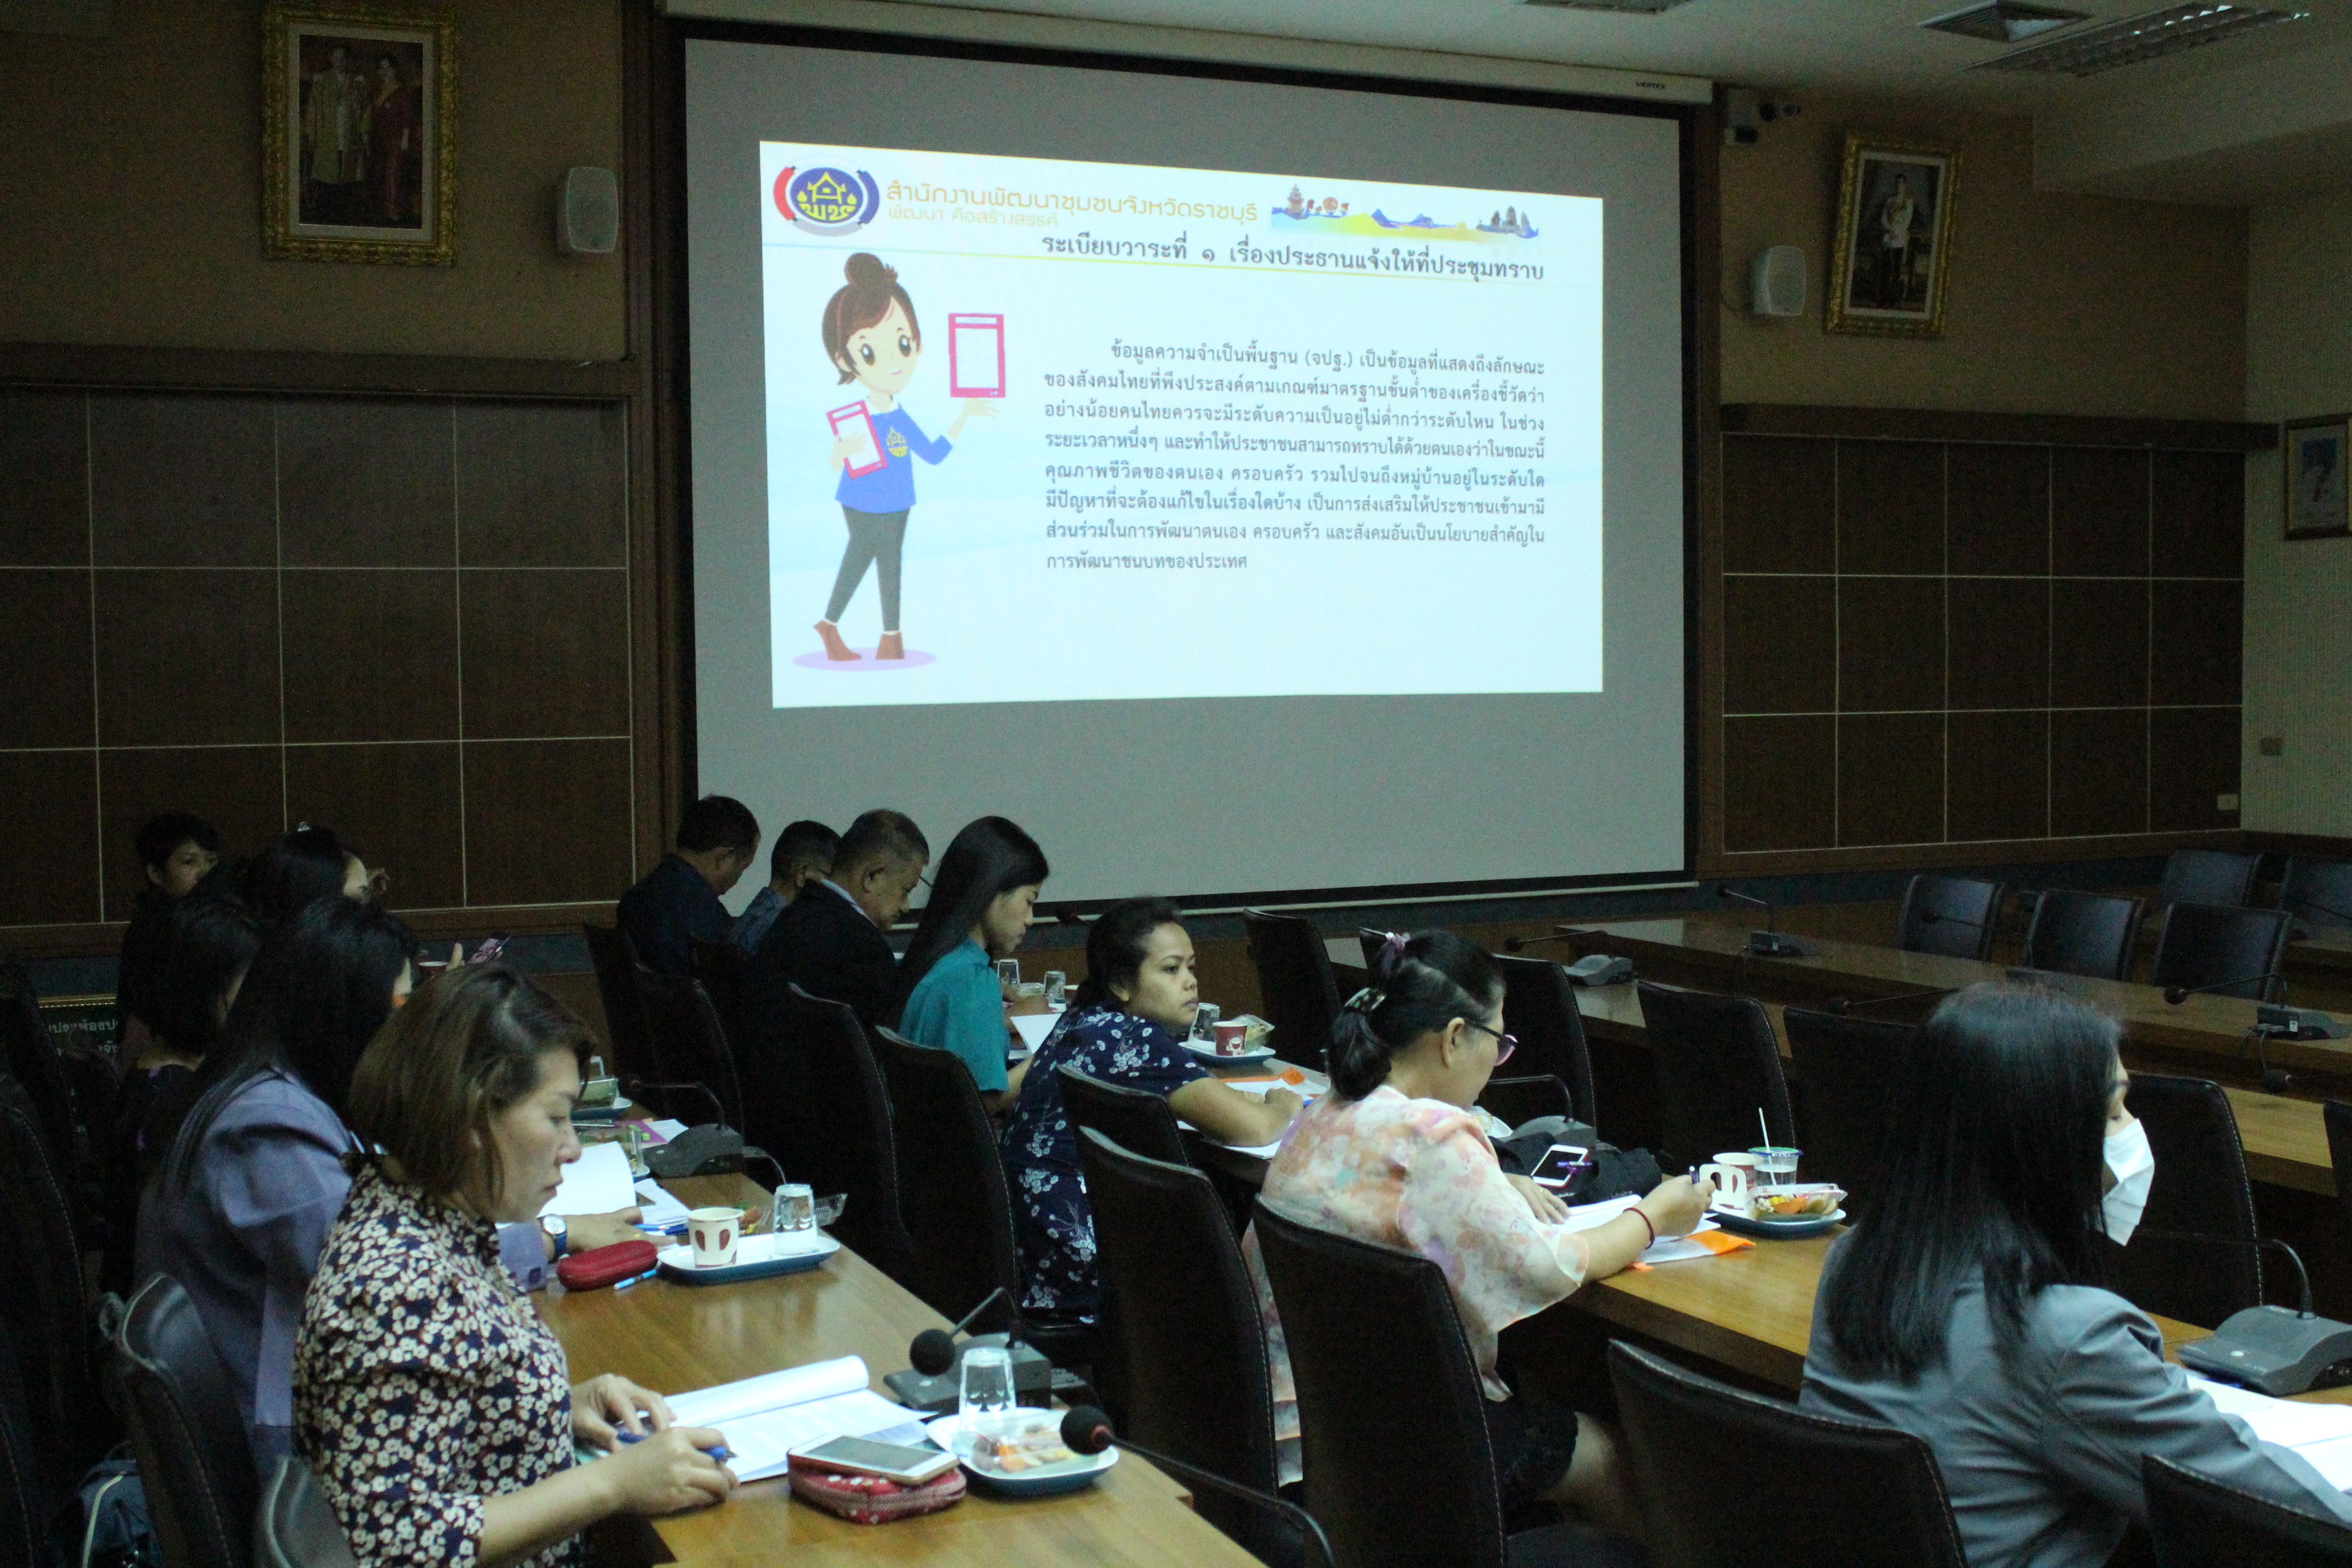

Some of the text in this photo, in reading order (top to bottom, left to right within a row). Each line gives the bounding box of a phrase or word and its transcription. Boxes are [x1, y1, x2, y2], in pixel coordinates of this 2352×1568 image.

[887, 180, 1258, 226] สำนักงานพัฒนาชุมชนจังหวัดราชบุรี
[888, 204, 1058, 227] พัฒนา คือสร้างสรรค์
[1042, 230, 1544, 282] ระเบียบวาระที่ ๑ เรื่องประธานแจ้งให้ที่ประชุมทราบ
[1111, 338, 1544, 375] ข้อมูลความจำเป็นพื้นฐาน (จปฐ.) เป็นข้อมูลที่แสดงถึงลักษณะ
[1045, 398, 1544, 431] อย่างน้อยคนไทยควรจะมีระดับความเป็นอยู่ไม่ต่ำกว่าระดับไหน ในช่วง
[1045, 460, 1544, 491] คุณภาพชีวิตของตนเอง ครอบครัว รวมไปจนถึงหมู่บ้านอยู่ในระดับใด
[1046, 485, 1544, 514] มีปัญหาที่จะต้องแก้ไขในเรื่องใดบ้าง เป็นการส่งเสริมให้ประชาชนเข้ามามี
[1046, 518, 1544, 548] ส่วนร่วมในการพัฒนาตนเอง ครอบครัว และสังคมอันเป็นนโยบายสำคัญใน
[1047, 549, 1248, 569] การพัฒนาชนบทของประเทศ
